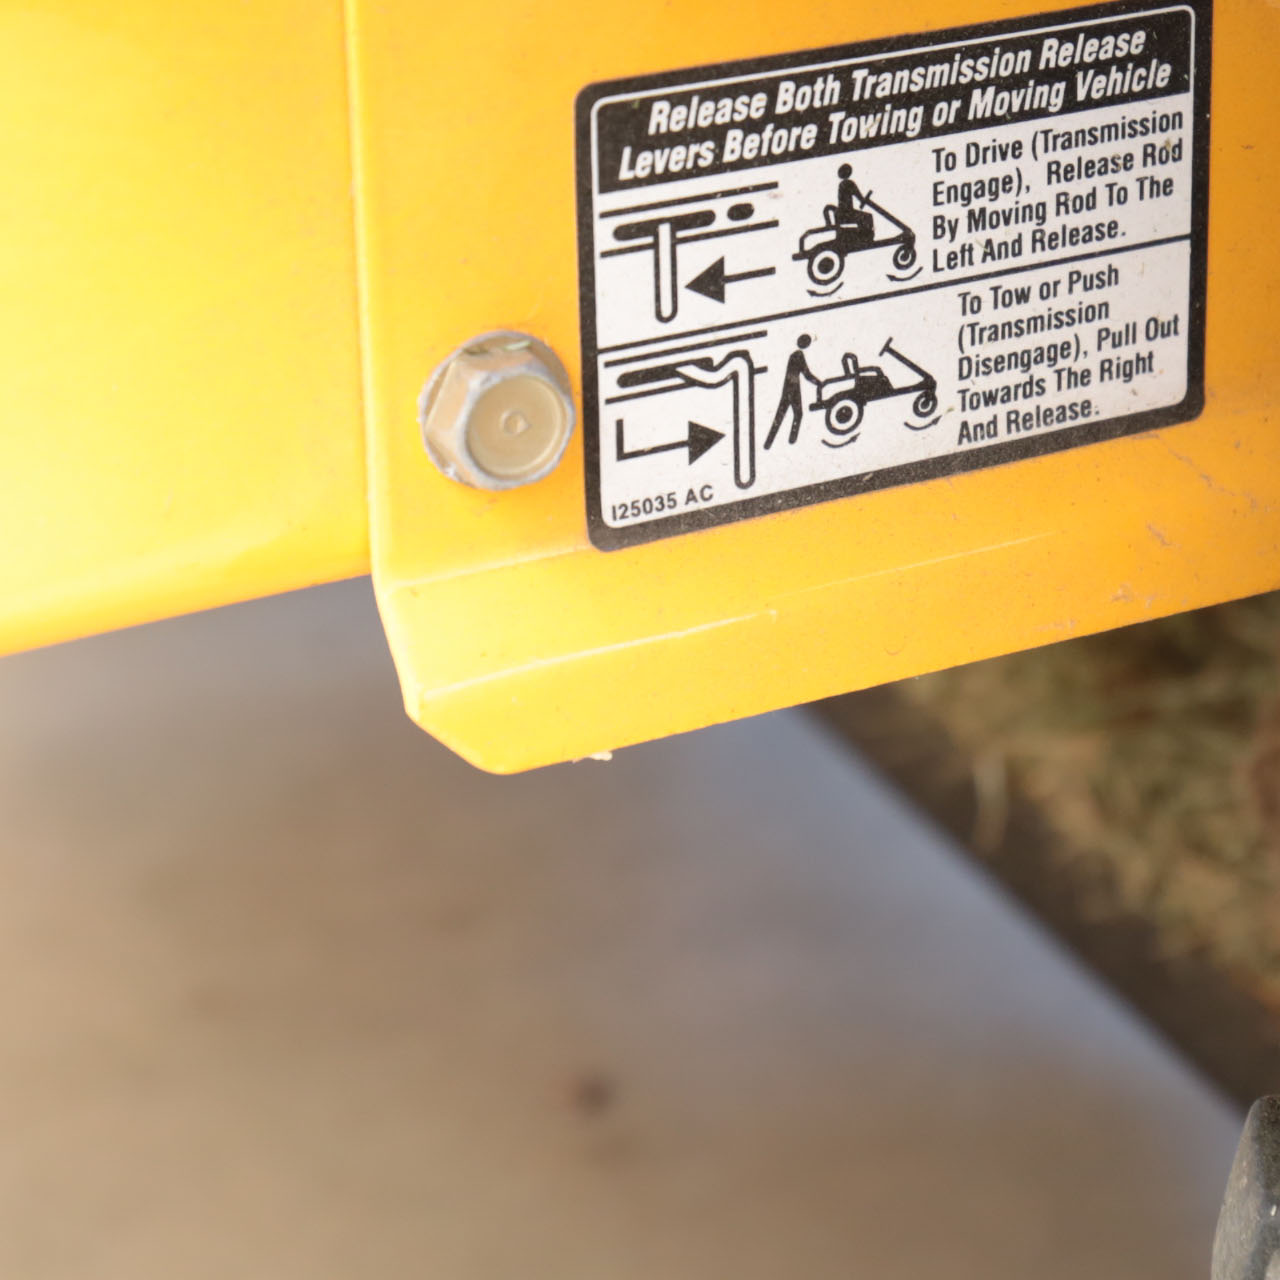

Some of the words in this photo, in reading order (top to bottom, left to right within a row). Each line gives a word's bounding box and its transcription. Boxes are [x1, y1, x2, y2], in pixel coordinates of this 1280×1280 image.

[648, 92, 768, 136] Release
[775, 74, 841, 115] Both
[852, 47, 1032, 102] Transmission
[1039, 30, 1146, 70] Release
[619, 140, 715, 181] Levers
[722, 123, 818, 163] Before
[828, 104, 923, 144] Towing
[932, 99, 961, 128] or
[968, 79, 1066, 121] Moving
[1076, 59, 1171, 102] Vehicle
[932, 147, 957, 173] To
[966, 139, 1023, 168] Drive
[1032, 110, 1183, 161] (Transmission
[932, 167, 1030, 207] Engage),
[1047, 151, 1134, 185] Release
[1142, 138, 1183, 168] Rod
[932, 215, 959, 243] By
[967, 201, 1047, 234] Moving
[1055, 186, 1097, 217] Rod
[1105, 183, 1128, 207] To
[1136, 177, 1174, 201] The
[932, 244, 974, 273] Left
[981, 233, 1022, 264] And
[1031, 220, 1126, 254] Release.
[957, 292, 982, 316] To
[989, 285, 1031, 310] Tow
[1039, 279, 1061, 301] or
[1068, 264, 1119, 295] Push
[958, 301, 1110, 354] (Transmission
[958, 333, 1088, 381] Disengage),
[1097, 322, 1137, 352] Pull
[1145, 314, 1179, 342] Out
[957, 374, 1046, 413] Towards
[1054, 367, 1092, 392] The
[1100, 351, 1154, 384] Right
[957, 415, 998, 446] And
[684, 484, 714, 505] AC
